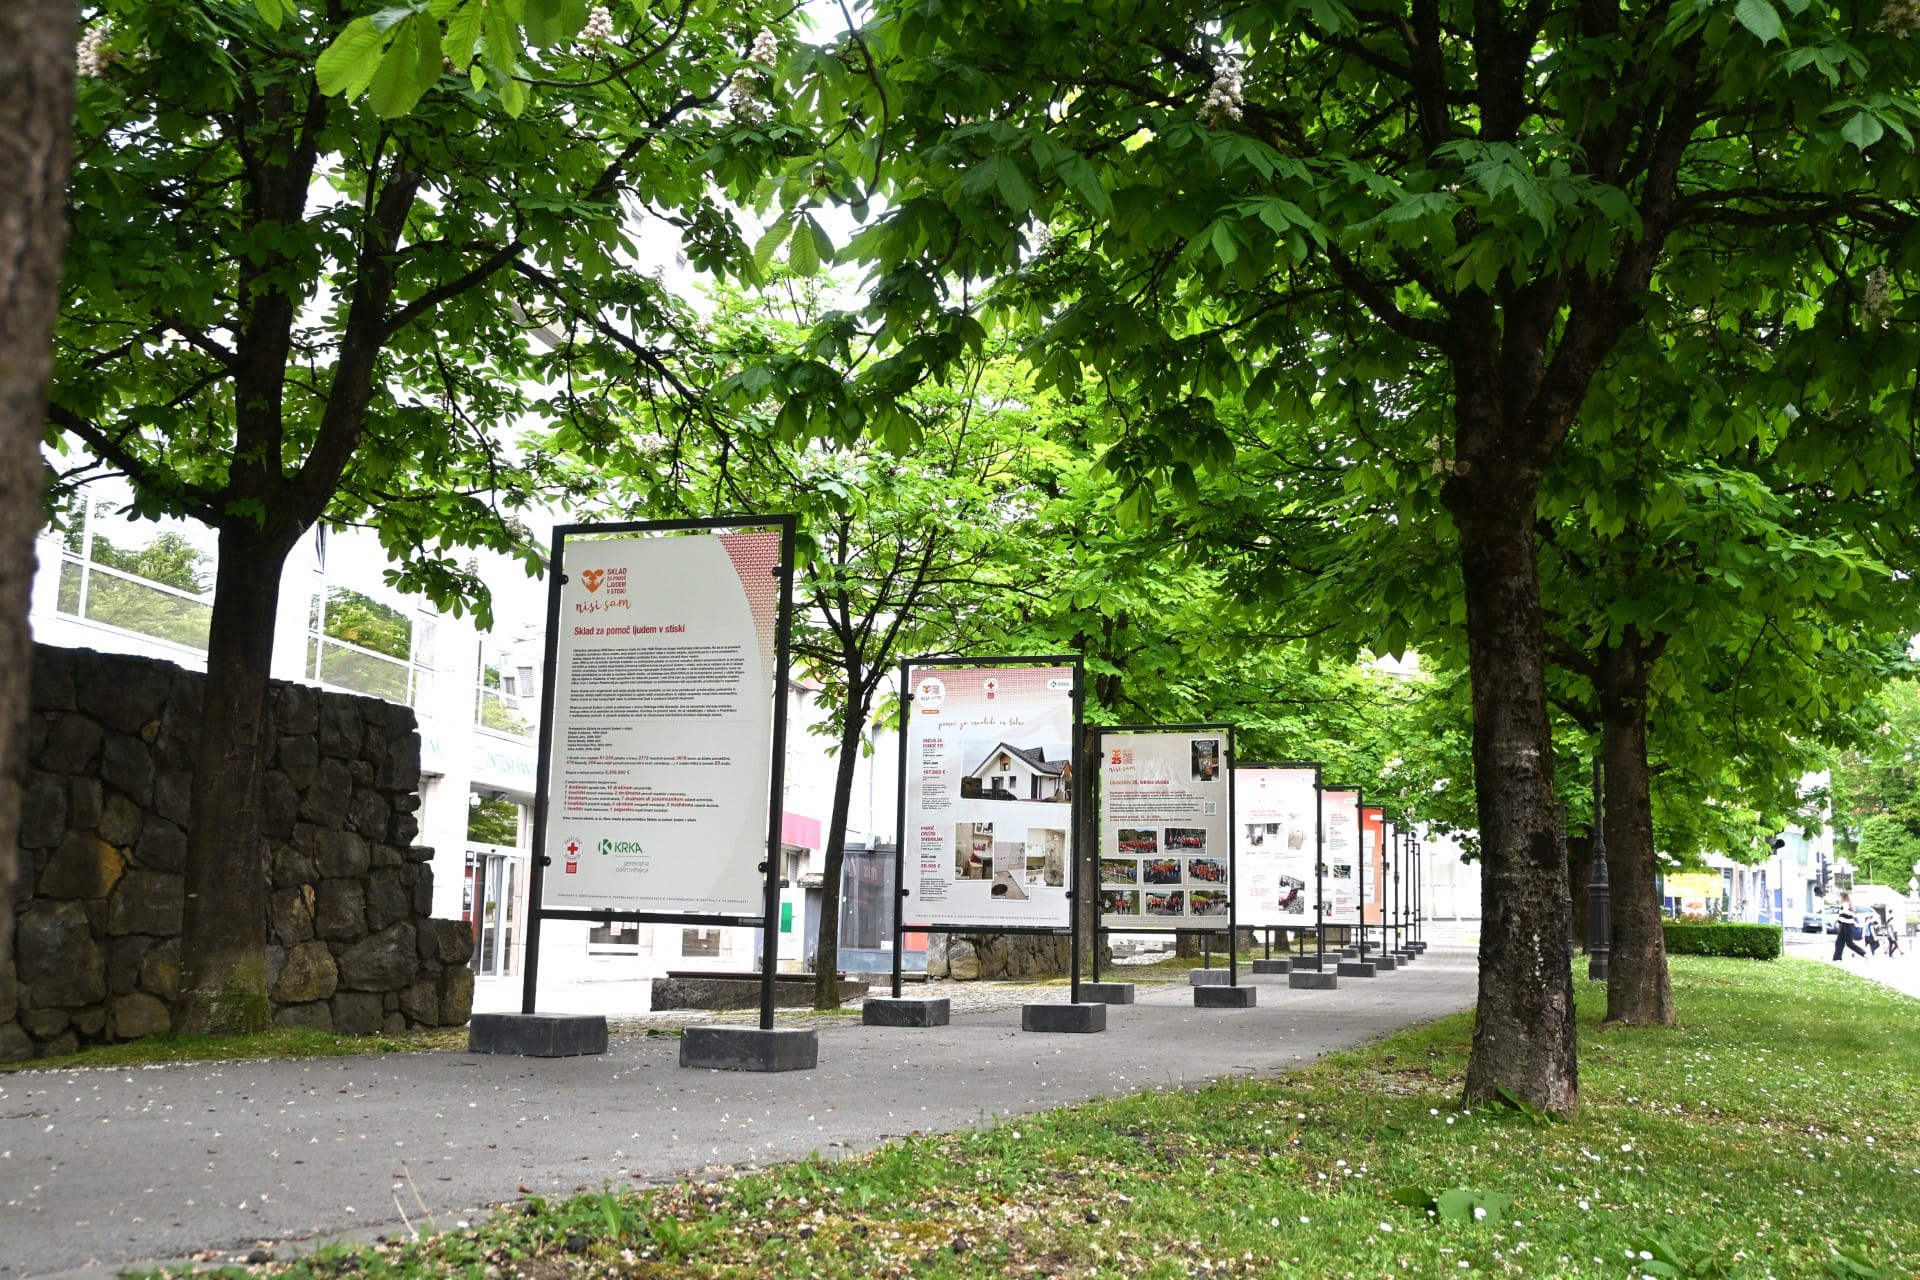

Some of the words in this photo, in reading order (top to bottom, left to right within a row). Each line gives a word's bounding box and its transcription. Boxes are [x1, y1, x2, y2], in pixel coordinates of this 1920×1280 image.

[576, 600, 601, 613] nisi
[604, 599, 631, 611] sam
[574, 626, 595, 635] Sklad
[606, 625, 631, 636] pomoč
[633, 625, 657, 635] ljudem
[664, 623, 685, 633] stiski
[614, 842, 643, 853] KRKA
